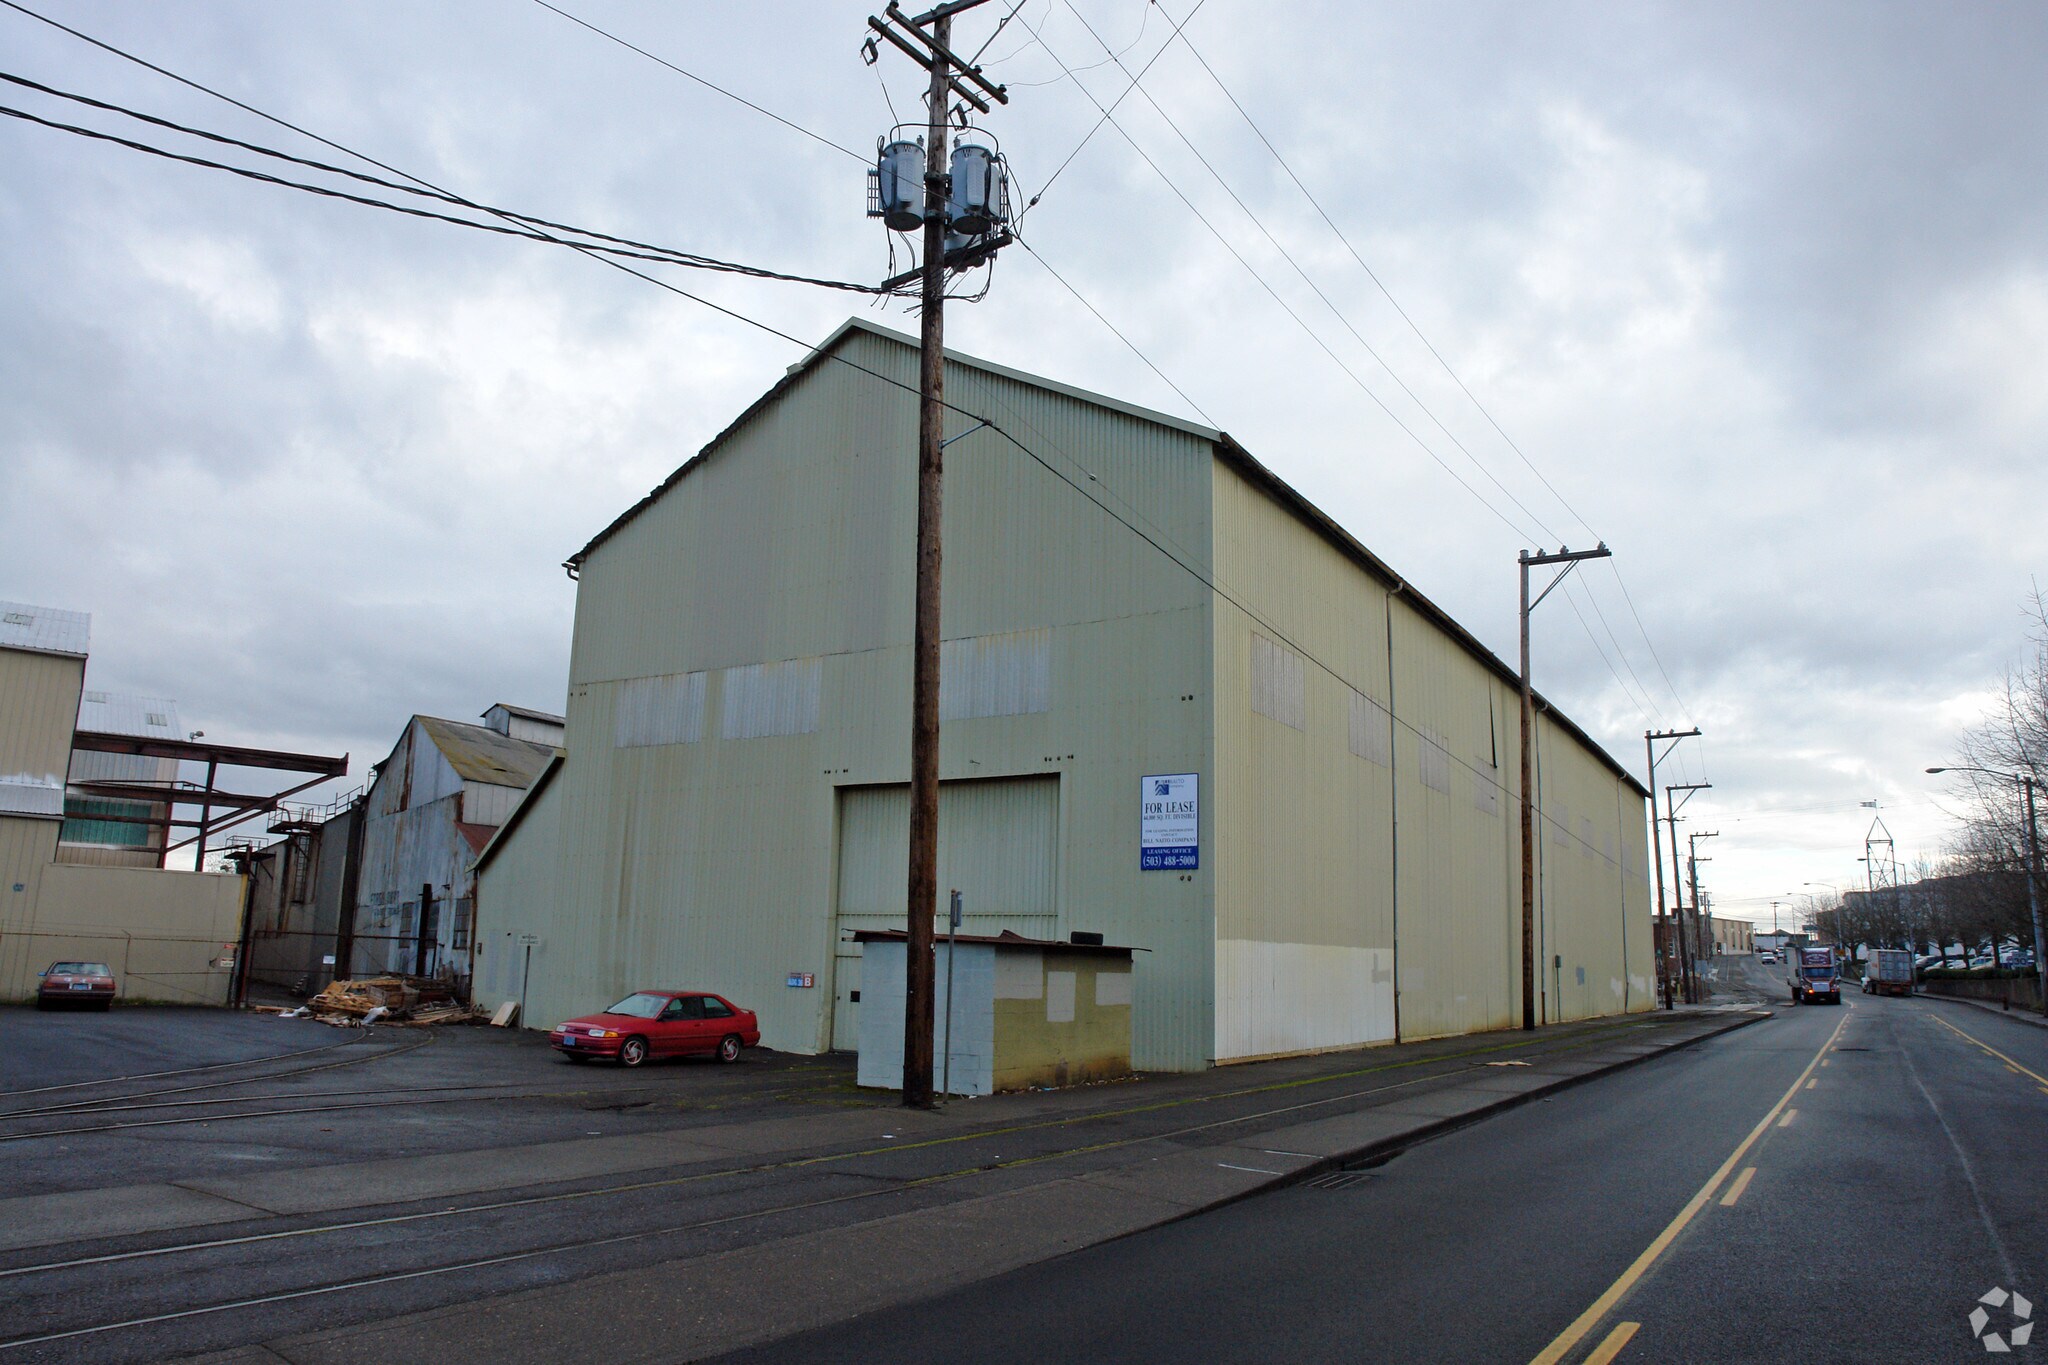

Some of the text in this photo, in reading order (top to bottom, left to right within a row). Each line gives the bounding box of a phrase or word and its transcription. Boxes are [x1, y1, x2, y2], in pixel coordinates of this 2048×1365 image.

[1145, 801, 1195, 814] FOR LEASE
[1143, 855, 1196, 867] (503) 488-5000
